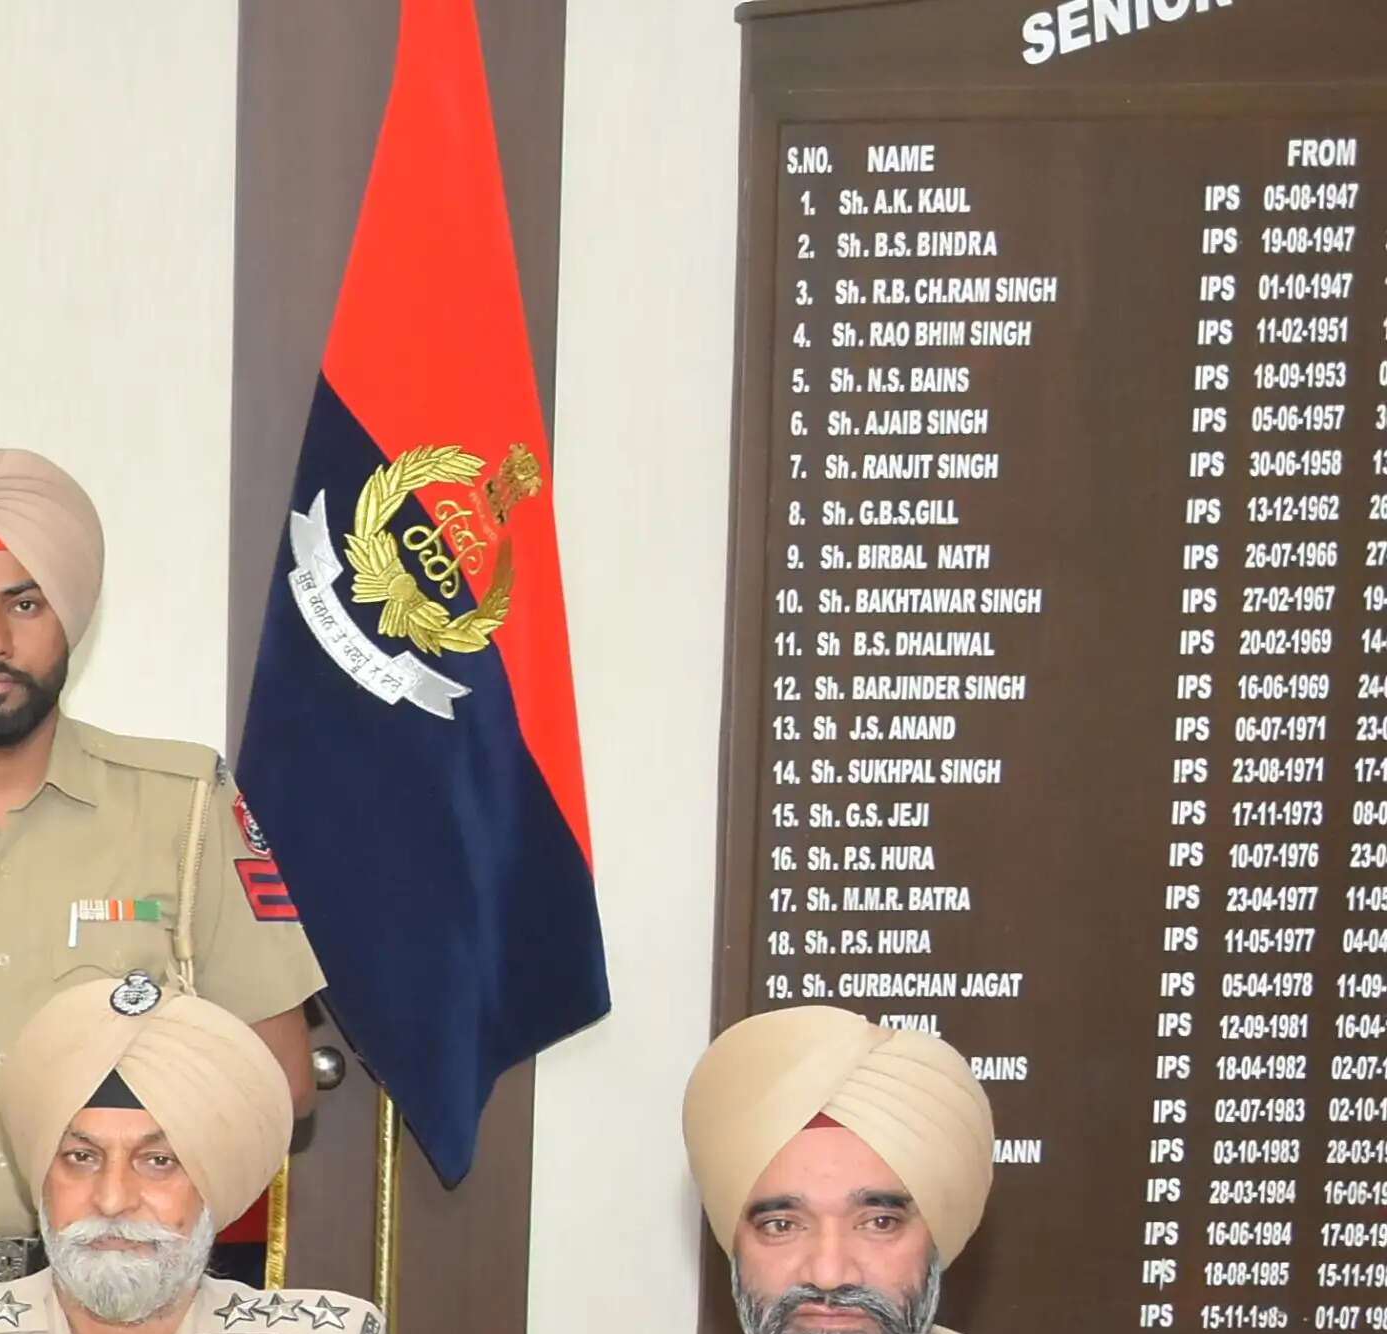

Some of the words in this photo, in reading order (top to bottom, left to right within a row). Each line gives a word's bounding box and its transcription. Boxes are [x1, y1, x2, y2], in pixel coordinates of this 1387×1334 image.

[787, 146, 833, 175] S.NO.
[867, 145, 936, 173] NAME
[1287, 138, 1358, 168] FROM
[801, 191, 815, 215] 1.
[839, 189, 868, 215] Sh.
[874, 189, 912, 214] A.K.
[918, 187, 971, 213] KAUL
[1205, 184, 1240, 211] IPS
[1264, 183, 1359, 211] 05-08-1947
[798, 234, 815, 259] 2.
[837, 233, 869, 258] Sh.
[875, 232, 912, 257] B.S.
[917, 231, 997, 256] BINDRA
[1202, 227, 1238, 254] IPS
[1261, 226, 1355, 253] 19-08-1947
[796, 280, 813, 305] 3.
[835, 279, 866, 304] Sh.
[873, 279, 910, 304] R.B.
[915, 278, 991, 303] CH.RAM
[995, 277, 1057, 302] SINGH
[1200, 275, 1235, 301] IPS
[1259, 272, 1353, 300] 01-10-1947
[793, 323, 811, 348] 4.
[832, 322, 864, 347] Sh.
[870, 322, 910, 347] RAO
[915, 322, 965, 346] BHIM
[970, 321, 1032, 346] SINGH
[1197, 319, 1233, 345] IPS
[1257, 317, 1348, 343] 11-02-1951
[792, 368, 810, 393] 5.
[830, 368, 862, 392] Sh.
[867, 368, 905, 392] N.S.
[910, 367, 969, 392] BAINS
[1195, 364, 1229, 390] IPS
[1254, 361, 1346, 389] 18-09-1953
[791, 411, 808, 436] 6.
[828, 410, 859, 436] Sh.
[864, 410, 922, 435] AJAIB
[927, 409, 988, 434] SINGH
[1192, 407, 1227, 432] IPS
[1252, 405, 1345, 432] 05-06-1957
[790, 454, 807, 479] 7.
[825, 454, 857, 479] Sh.
[862, 454, 933, 479] RANJIT
[937, 454, 999, 479] SINGH
[1190, 451, 1225, 477] IPS
[1249, 450, 1343, 477] 30-06-1958
[789, 501, 806, 525] 8.
[822, 501, 854, 525] Sh.
[859, 500, 959, 525] G.B.S.GILL
[1186, 498, 1221, 524] IPS
[1247, 494, 1340, 522] 13-12-1962
[787, 544, 804, 569] 9.
[820, 545, 852, 569] Sh.
[858, 545, 928, 569] BIRBAL
[938, 544, 990, 569] NATH
[1183, 544, 1219, 570] IPS
[1245, 541, 1338, 568] 26-07-1966
[776, 589, 803, 614] 10.
[819, 589, 850, 613] Sh.
[855, 589, 976, 613] BAKHTAWAR
[980, 588, 1042, 613] SINGH
[1243, 585, 1336, 612] 27-02-1967
[775, 632, 802, 656] 11.
[854, 631, 890, 656] B.S.
[895, 632, 995, 656] DHALIWAL
[1240, 628, 1332, 655] 20-02-1969
[774, 676, 801, 700] 12.
[815, 676, 845, 700] Sh.
[852, 676, 960, 700] BARJINDER
[964, 675, 1026, 700] SINGH
[1238, 674, 1330, 699] 16-06-1969
[773, 716, 800, 740] 13.
[849, 716, 884, 740] J.S.
[888, 716, 956, 740] ANAND
[1235, 716, 1326, 742] 06-07-1971
[773, 760, 800, 784] 14.
[811, 759, 843, 783] Sh.
[848, 759, 936, 783] SUKHPAL
[940, 759, 1001, 784] SINGH
[1232, 757, 1324, 783] 23-08-1971
[772, 803, 799, 827] 15.
[809, 803, 841, 827] Sh.
[846, 803, 883, 827] G.S.
[888, 803, 929, 827] JEJI
[1232, 801, 1323, 826] 17-11-1973
[771, 846, 797, 870] 16.
[807, 846, 839, 870] Sh.
[844, 846, 876, 870] P.S.
[881, 846, 935, 870] HURA
[1229, 843, 1319, 868] 10-07-1976
[770, 888, 797, 912] 17.
[807, 887, 838, 911] Sh.
[843, 887, 903, 911] M.M.R.
[908, 887, 971, 911] BATRA
[1226, 886, 1319, 912] 23-04-1977
[768, 931, 795, 955] 18.
[805, 930, 836, 954] Sh.
[841, 930, 873, 954] P.S.
[878, 930, 931, 954] HURA
[1225, 928, 1316, 953] 11-05-1977
[766, 975, 792, 999] 19.
[802, 974, 833, 997] Sh.
[839, 973, 957, 997] GURBACHAN
[961, 973, 1023, 997] JAGAT
[1222, 972, 1313, 998] 05-04-1978
[1219, 1014, 1308, 1039] 12-09-1981
[970, 1056, 1027, 1080] BAINS
[1216, 1055, 1306, 1080] 18-04-1982
[1213, 1139, 1300, 1164] 03-10-1983
